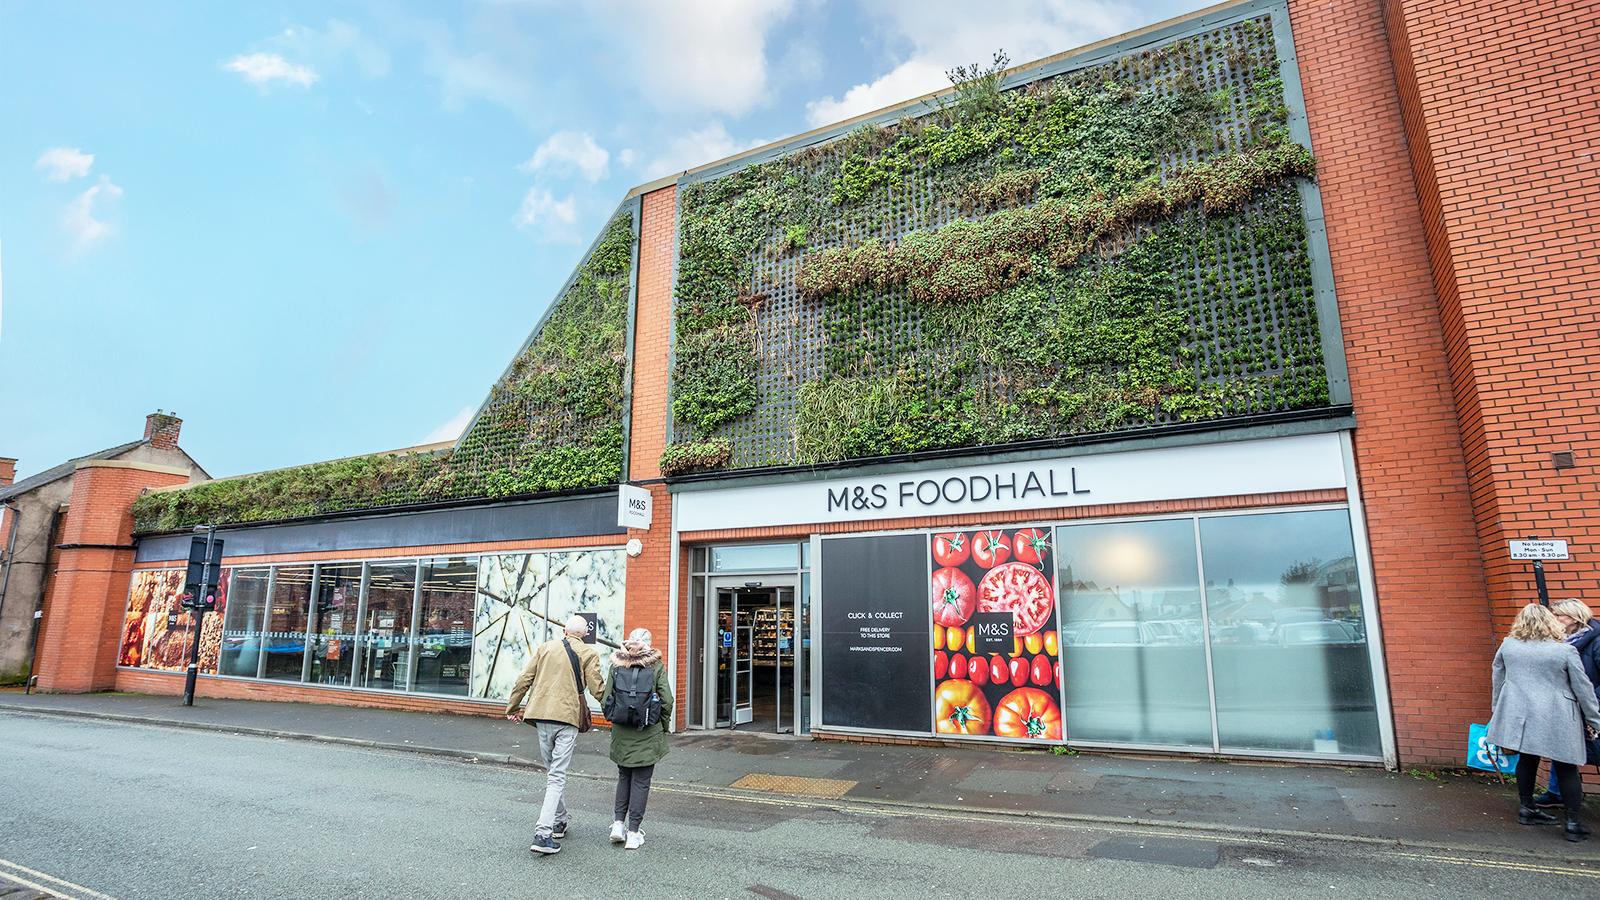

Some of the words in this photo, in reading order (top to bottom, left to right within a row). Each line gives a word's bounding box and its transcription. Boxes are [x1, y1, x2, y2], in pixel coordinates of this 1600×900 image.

[827, 483, 887, 512] M&S
[899, 467, 1091, 507] FOODHALL
[629, 499, 646, 510] M&S
[874, 611, 904, 619] COLLECT
[979, 623, 1009, 636] M&S
